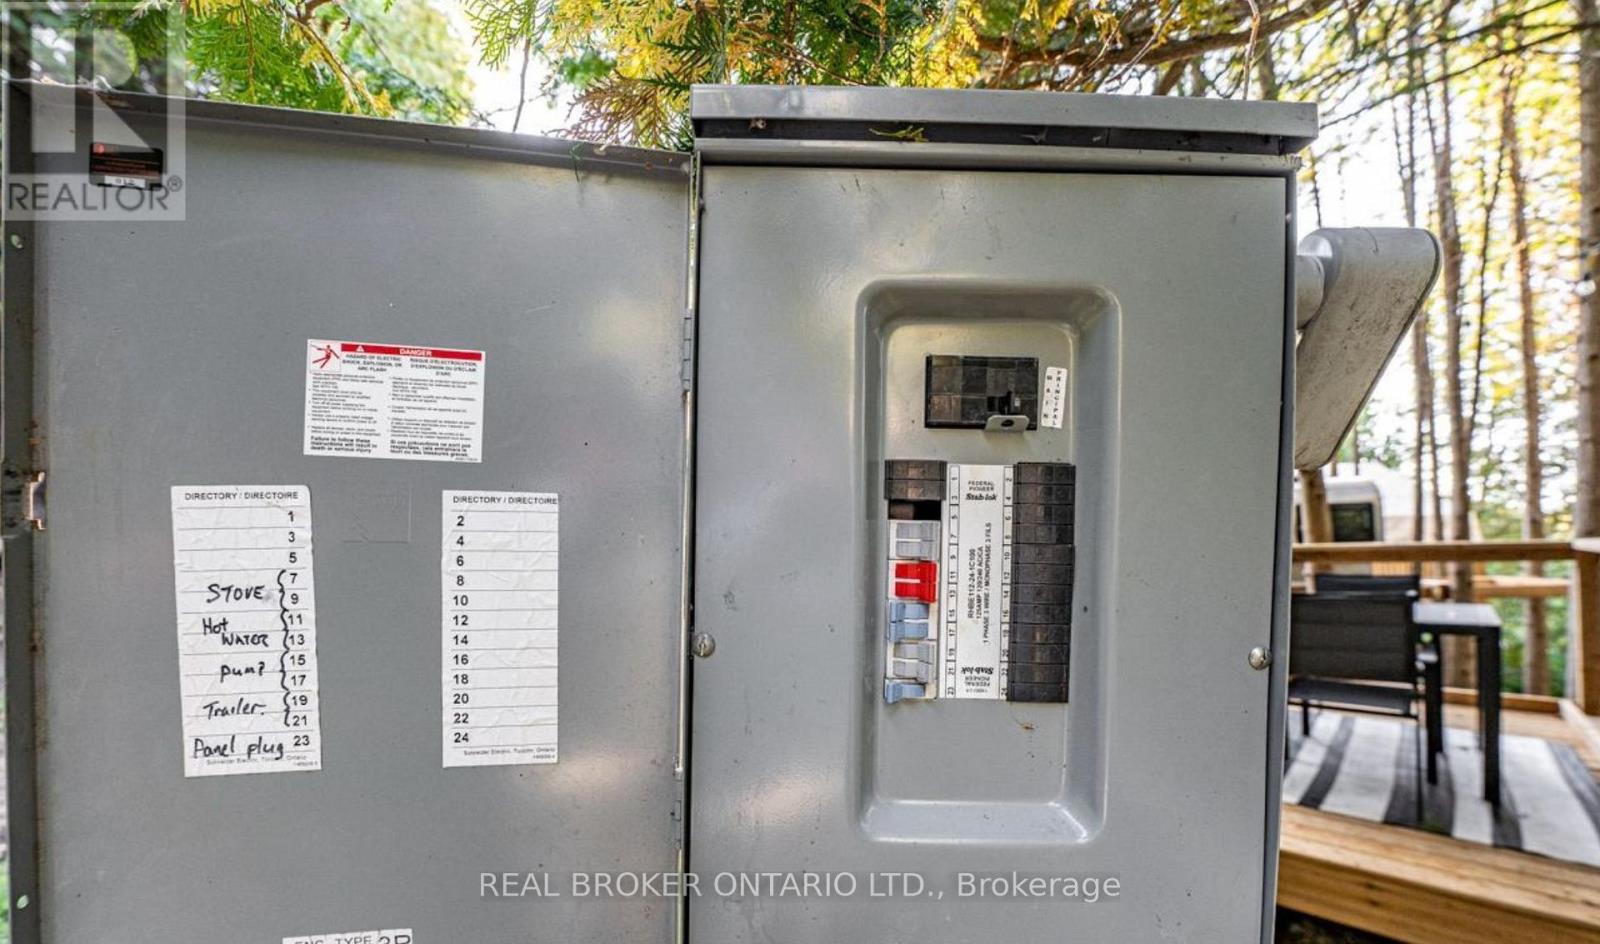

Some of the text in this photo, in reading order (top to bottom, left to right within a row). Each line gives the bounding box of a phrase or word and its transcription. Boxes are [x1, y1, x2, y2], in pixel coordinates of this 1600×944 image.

[399, 348, 433, 357] DANGER
[184, 492, 237, 501] DIRECTORY
[244, 491, 299, 501] DIRECTOIRE
[452, 496, 502, 504] DIRECTORY
[508, 497, 558, 505] DIRECTOIRE
[288, 511, 294, 522] 1
[456, 515, 465, 527] 2
[288, 532, 296, 543] 3
[456, 536, 465, 546] 4
[289, 552, 297, 563] 5
[456, 556, 465, 567] 6
[290, 573, 297, 584] 7
[456, 575, 465, 587] 8
[206, 584, 266, 604] STOVE
[291, 593, 300, 604] 9
[452, 595, 469, 606] 10
[288, 614, 303, 625] 11
[452, 615, 469, 626] 12
[202, 617, 229, 635] Hot
[289, 634, 305, 646] 13
[452, 635, 469, 646] 14
[290, 655, 306, 666] 15
[452, 654, 469, 666] 16
[291, 674, 307, 686] 17
[452, 674, 469, 685] 18
[291, 695, 308, 706] 19
[453, 693, 470, 705] 20
[292, 715, 308, 726] 21
[453, 713, 469, 724] 22
[293, 735, 310, 746] 23
[454, 732, 469, 743] 24
[192, 734, 285, 761] Panel plug
